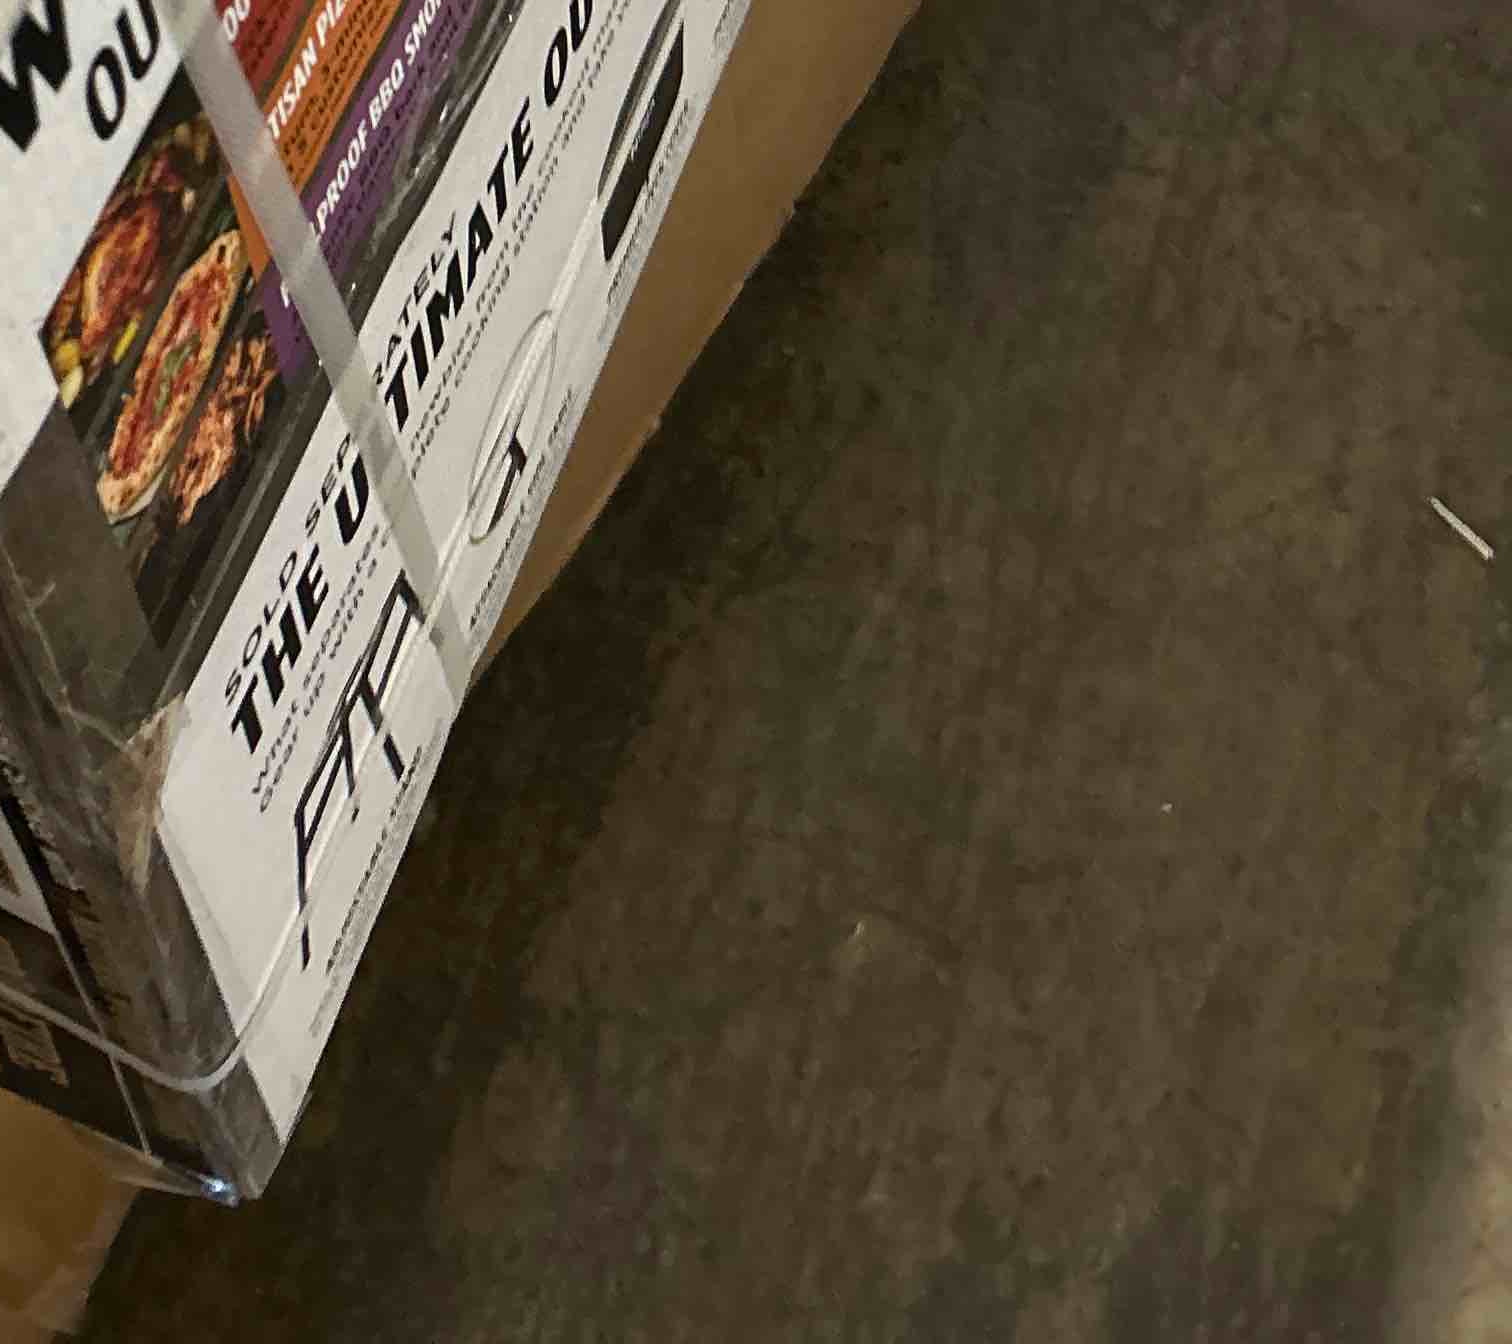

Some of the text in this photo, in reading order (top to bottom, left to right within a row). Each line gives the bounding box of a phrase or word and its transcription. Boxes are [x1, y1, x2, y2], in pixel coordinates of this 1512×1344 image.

[266, 34, 317, 149] TISAN
[279, 117, 371, 310] FLPROOF
[367, 45, 405, 135] BBQ
[222, 541, 299, 714] SOLD
[302, 207, 458, 542] SEPRATELY
[230, 542, 330, 771] THE
[332, 92, 536, 557] UTIMATE
[251, 694, 299, 804] What
[302, 516, 380, 696] separates
[410, 313, 472, 461] newbies
[475, 234, 509, 319] from
[511, 175, 534, 235] the
[258, 722, 301, 818] Gear
[303, 673, 324, 724] up
[329, 582, 364, 665] with
[380, 390, 450, 550] cplete
[453, 261, 510, 395] cooking
[513, 150, 558, 261] station
[560, 87, 585, 153] and
